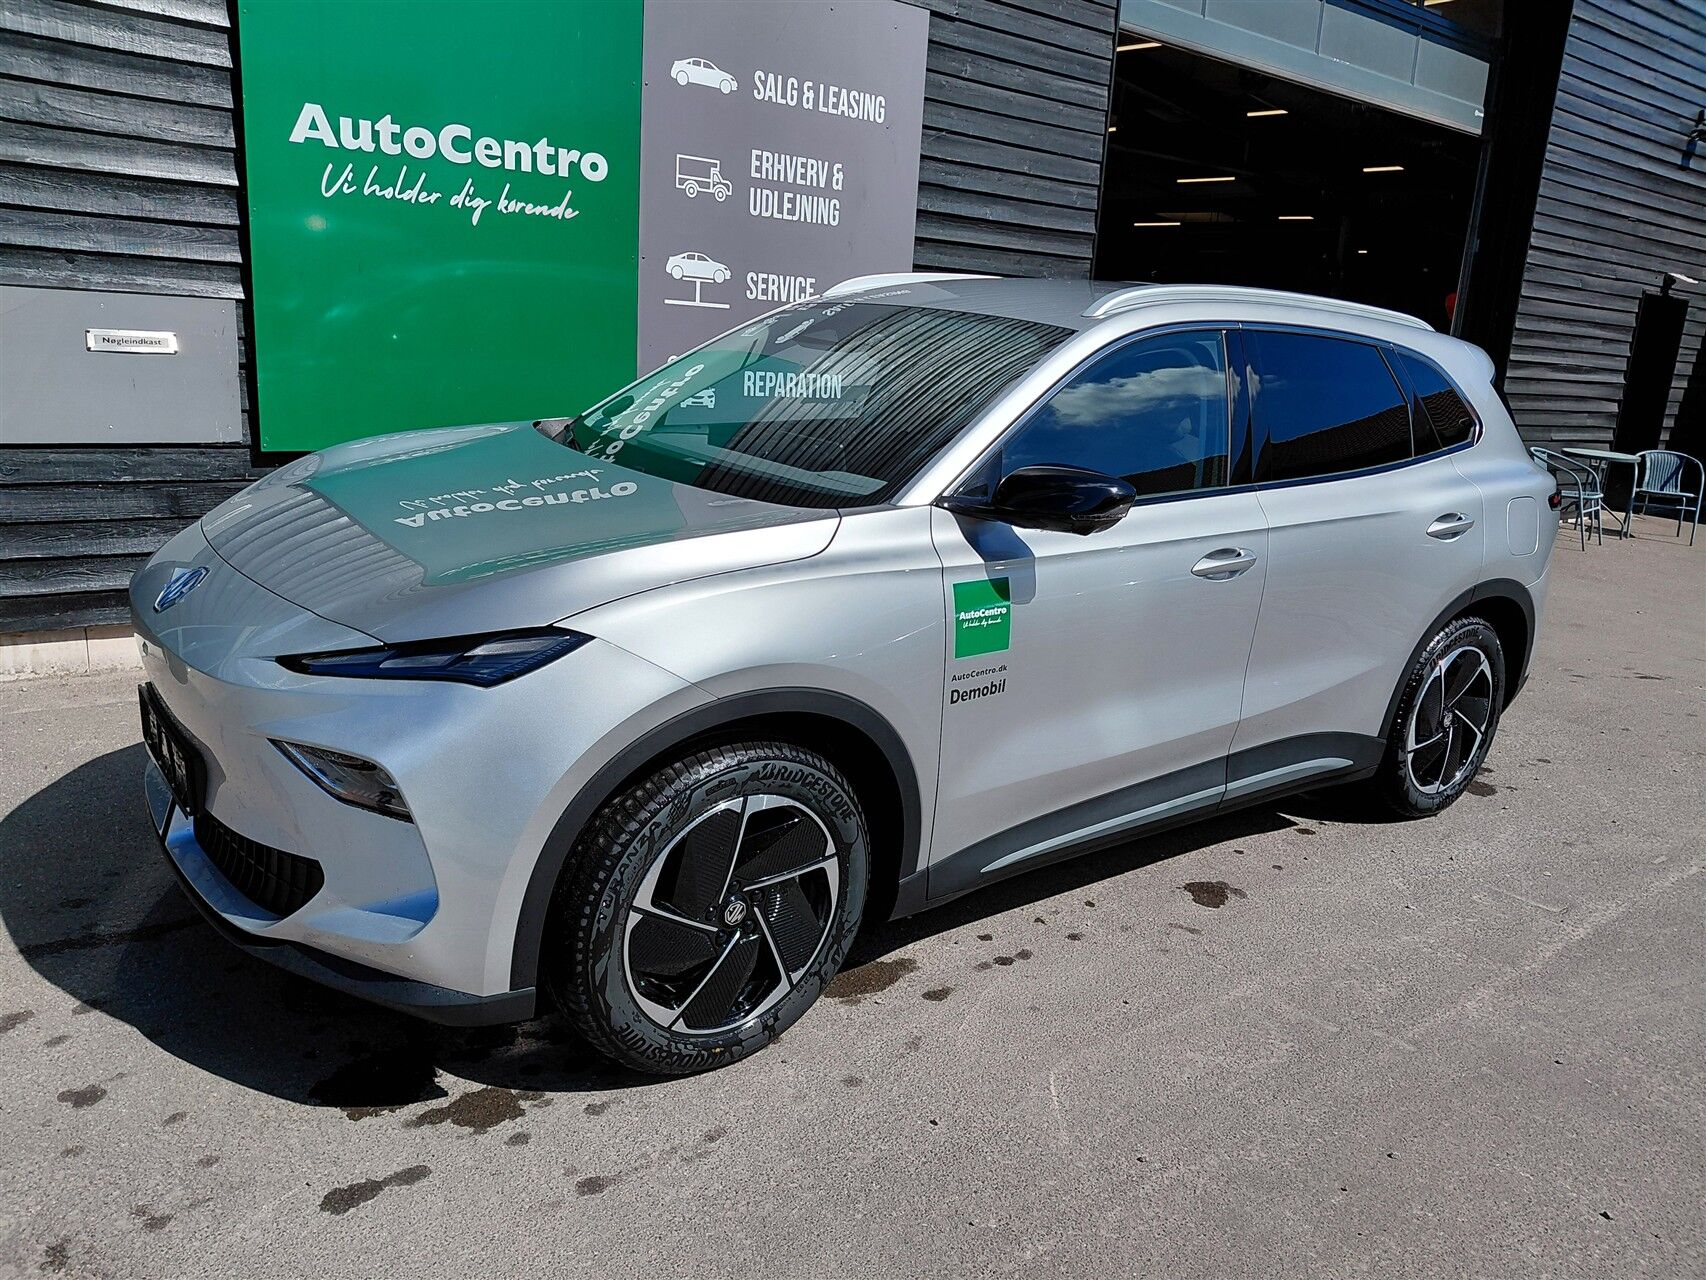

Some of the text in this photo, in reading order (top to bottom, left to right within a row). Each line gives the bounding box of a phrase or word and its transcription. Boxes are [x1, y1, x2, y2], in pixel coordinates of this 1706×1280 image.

[753, 70, 886, 124] SALG & LEASING
[288, 102, 609, 182] AutoCentro
[750, 149, 844, 191] ERHVERV &
[320, 163, 357, 199] Vi
[363, 165, 443, 205] holder
[449, 178, 493, 227] dig
[749, 187, 840, 226] UDLEJNING
[746, 272, 816, 303] SERVICE
[102, 336, 162, 346] Nøgleindkast
[743, 370, 842, 399] REPARATION
[959, 606, 1007, 620] AutoCentro
[951, 664, 1008, 682] AutoCentro.dk
[950, 679, 1006, 705] Demobil
[758, 762, 856, 824] BRIDGESTONE
